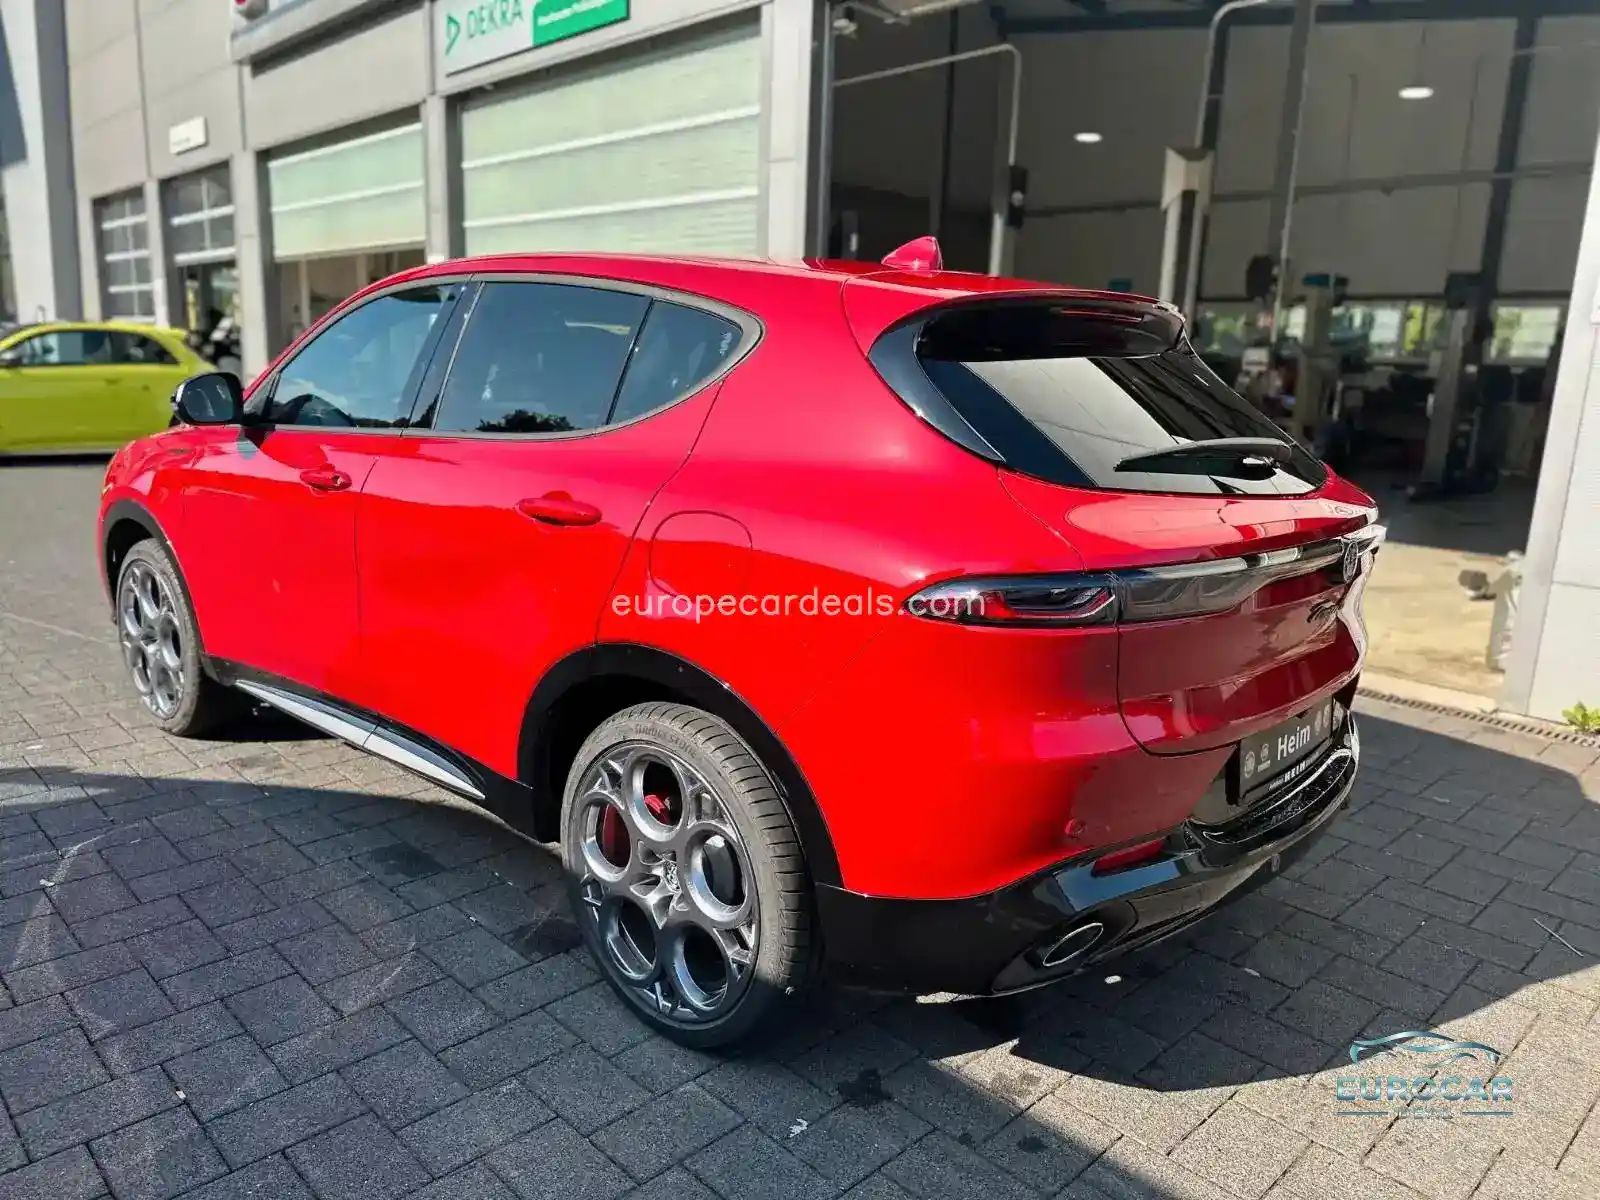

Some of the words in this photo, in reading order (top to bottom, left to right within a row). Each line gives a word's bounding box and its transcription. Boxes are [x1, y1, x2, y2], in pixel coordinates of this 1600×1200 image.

[467, 0, 524, 39] DEKRA
[1277, 725, 1311, 761] Heim
[1284, 760, 1307, 782] HEIM
